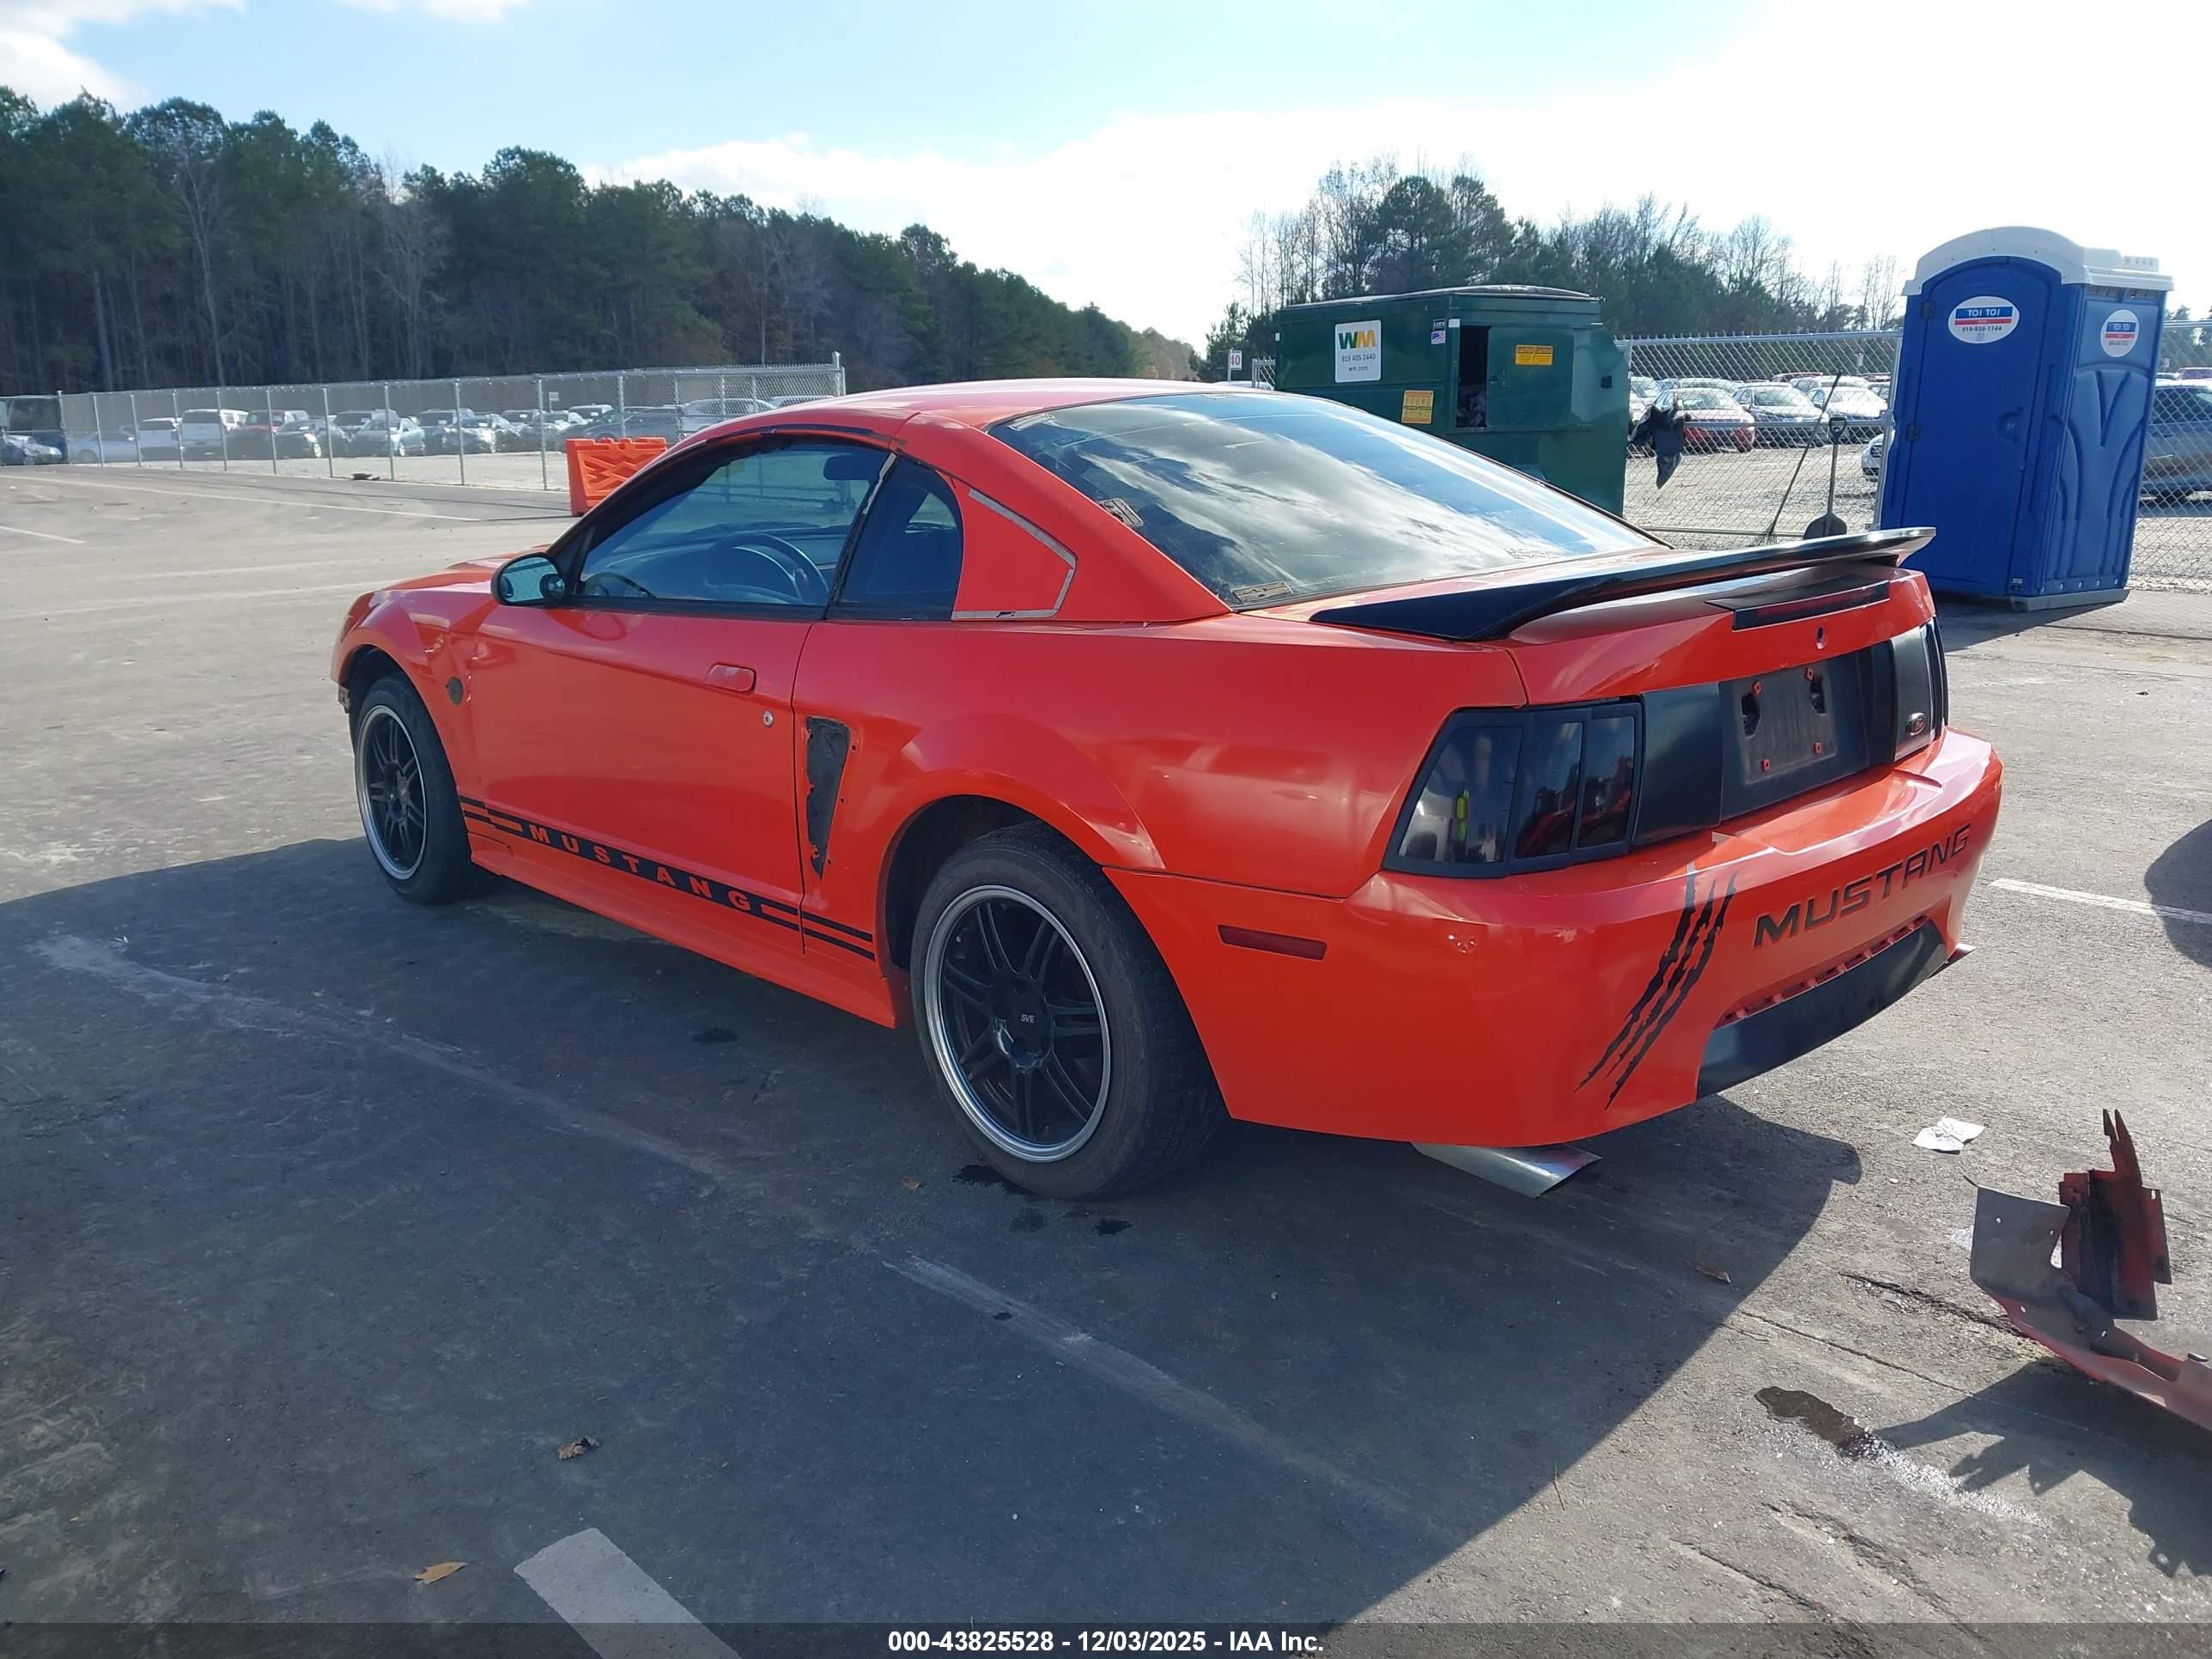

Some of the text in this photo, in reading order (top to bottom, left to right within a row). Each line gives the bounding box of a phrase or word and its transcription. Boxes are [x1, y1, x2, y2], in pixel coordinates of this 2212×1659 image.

[1985, 308, 2001, 317] TOI
[1339, 330, 1376, 349] WM
[529, 823, 751, 911] MUSTANG
[1753, 823, 1971, 949] MUSTANG
[1021, 1014, 1035, 1023] SVE
